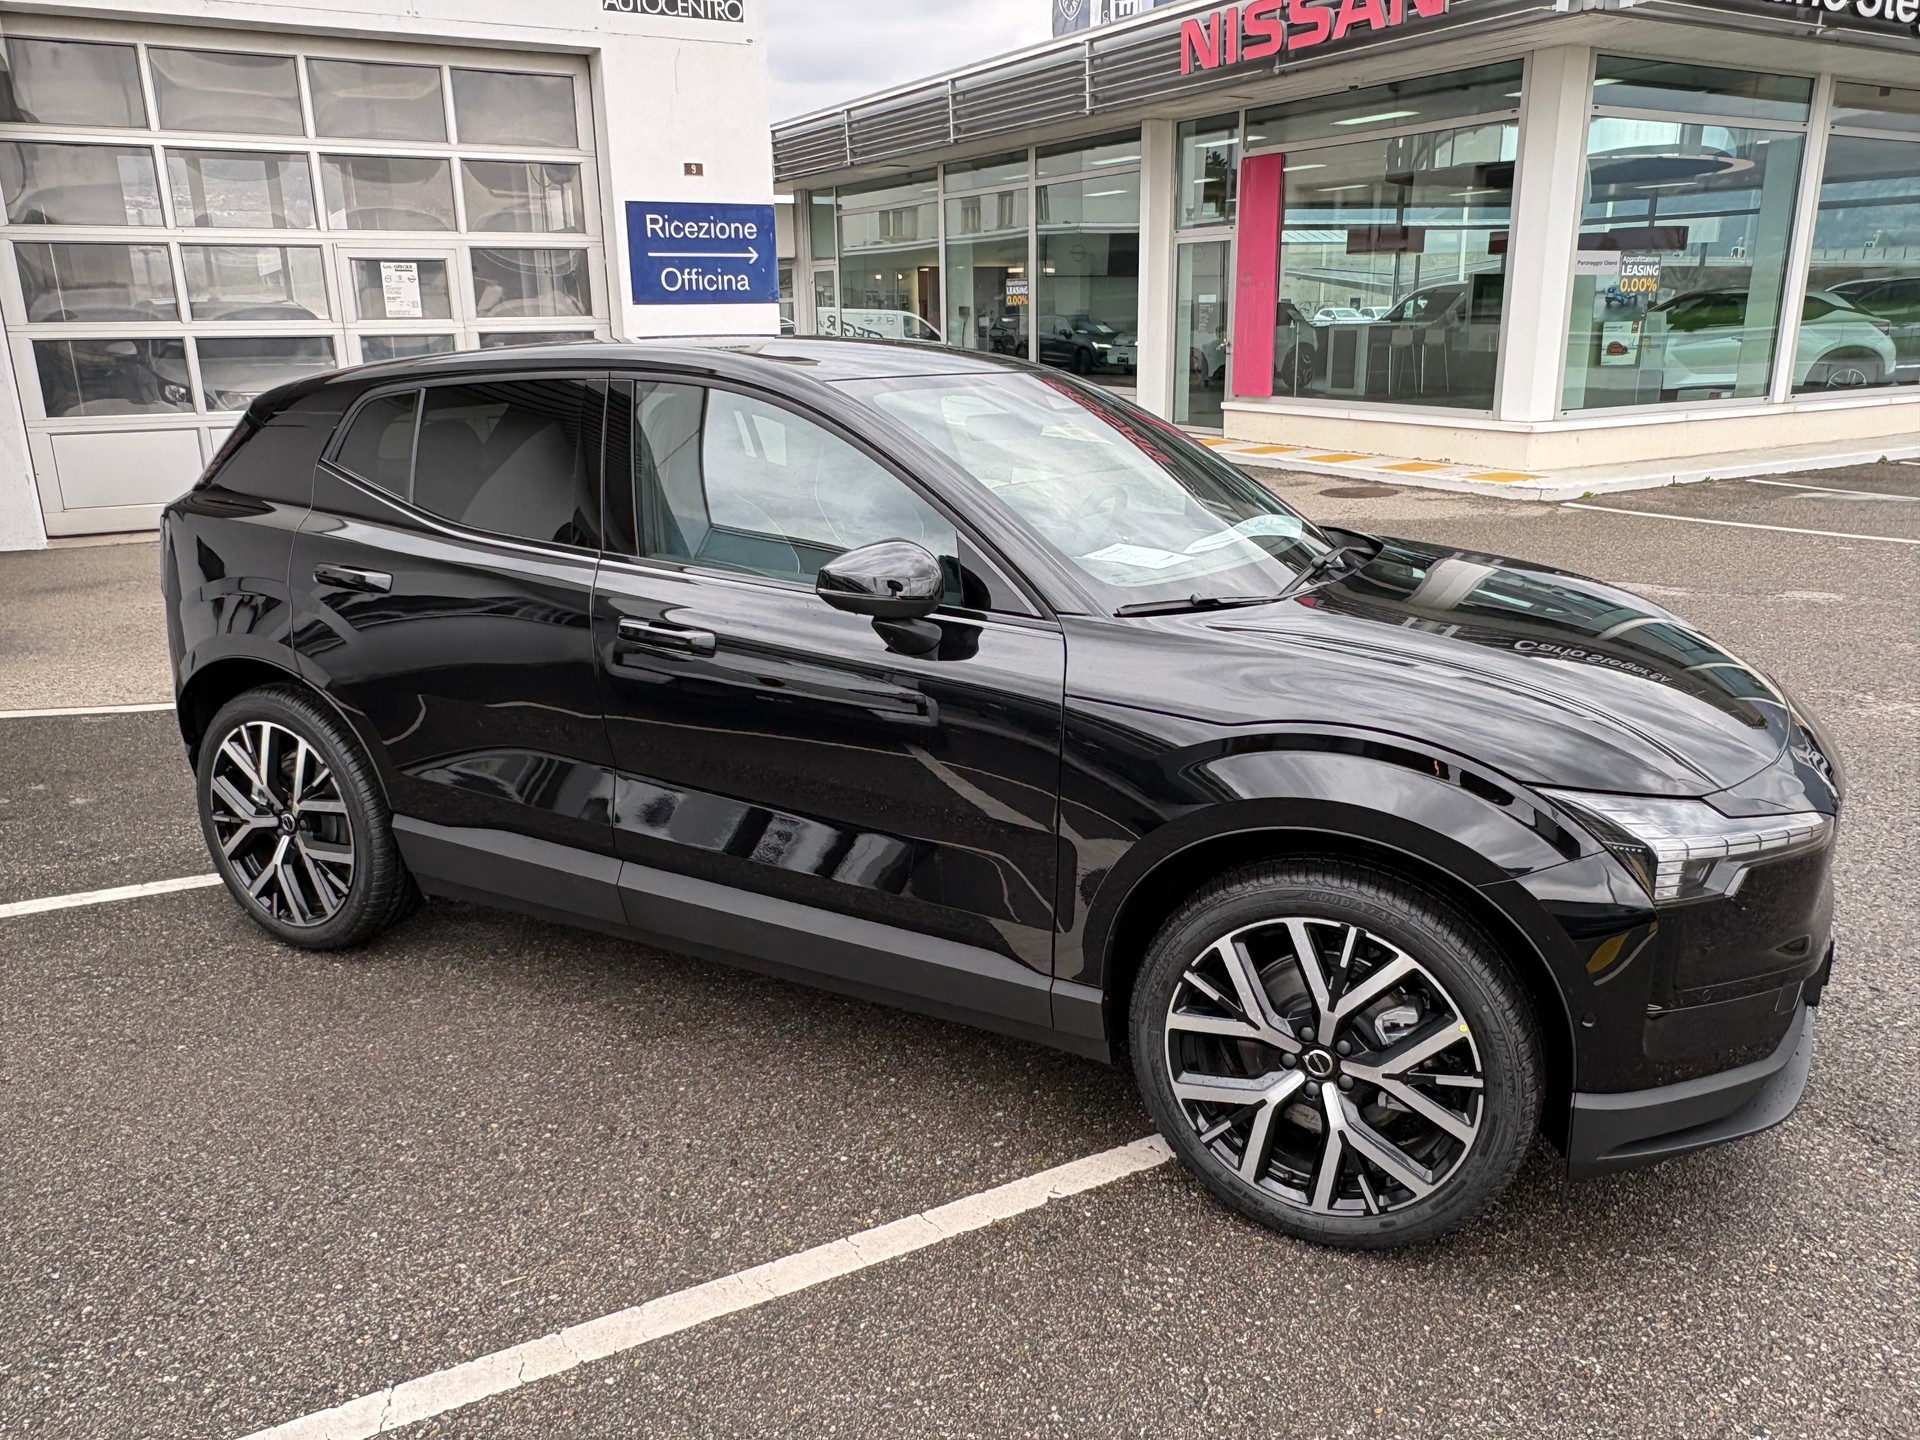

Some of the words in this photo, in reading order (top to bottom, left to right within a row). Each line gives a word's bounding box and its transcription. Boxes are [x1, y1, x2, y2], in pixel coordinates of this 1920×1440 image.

[1180, 0, 1449, 75] NISSAN
[690, 164, 697, 174] 9
[645, 214, 758, 240] Ricezione
[660, 267, 751, 292] Officina
[1621, 264, 1660, 276] LEASING
[1620, 277, 1657, 293] 0.00%
